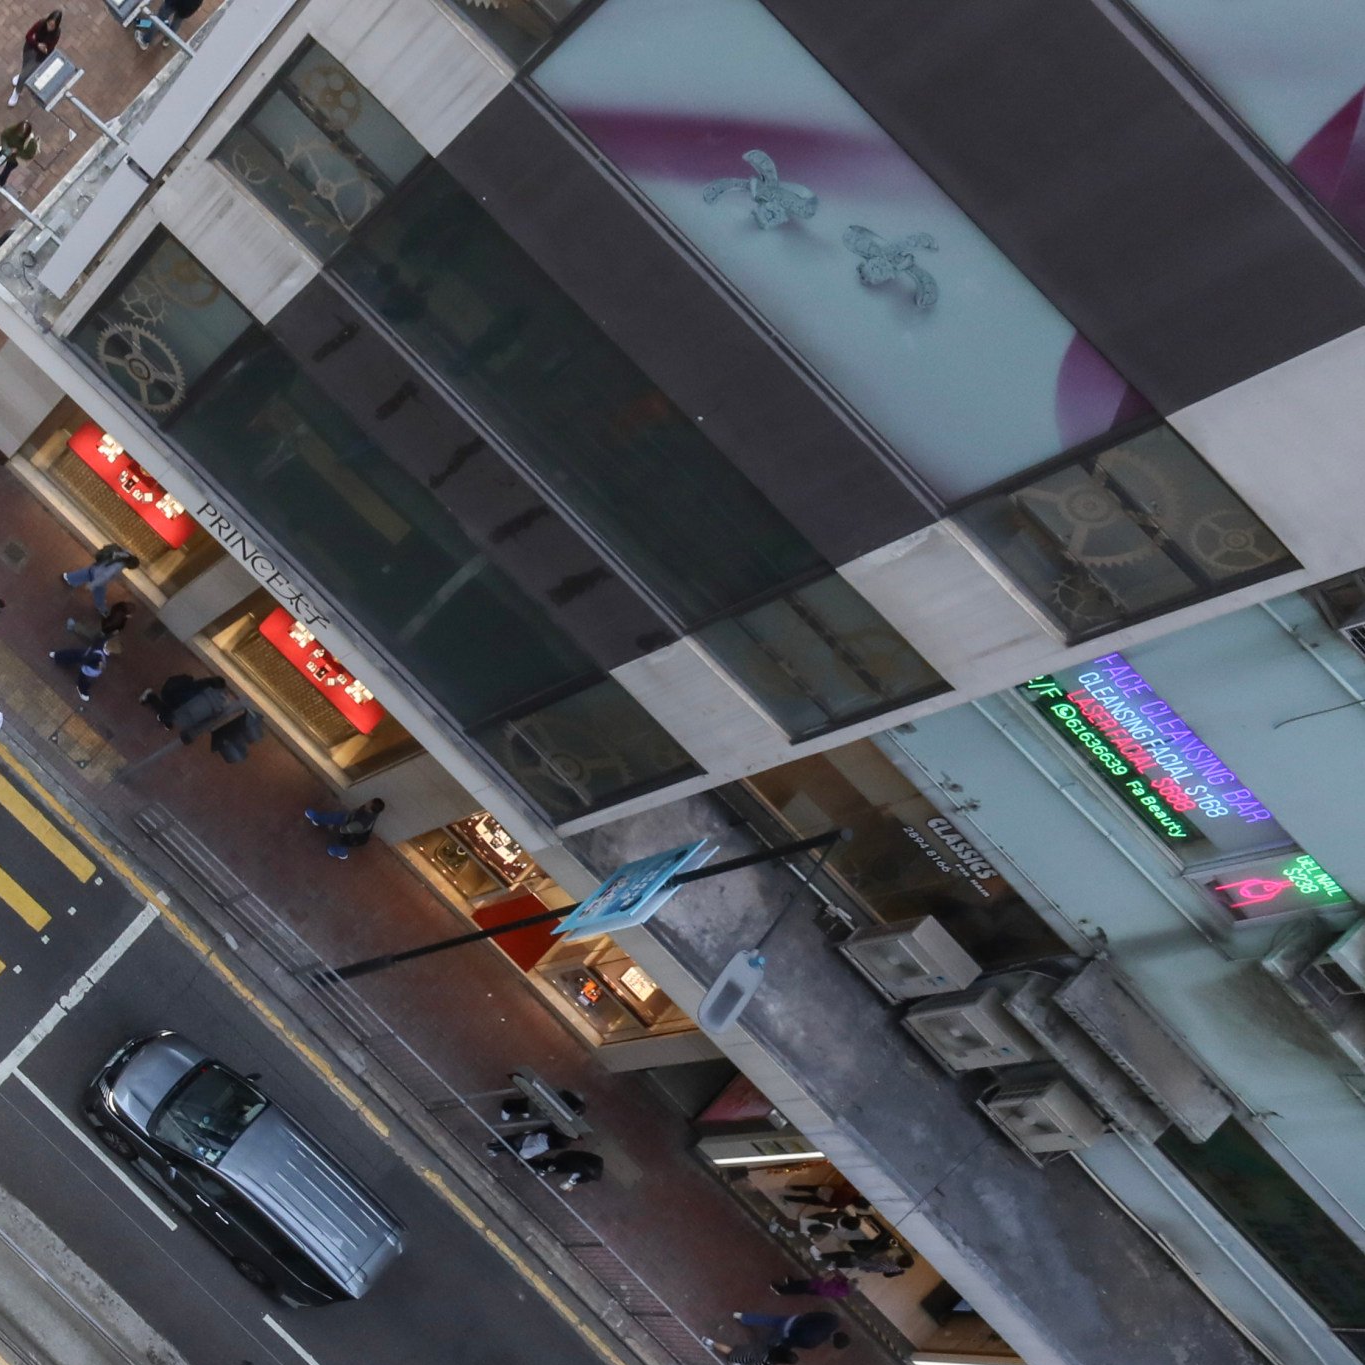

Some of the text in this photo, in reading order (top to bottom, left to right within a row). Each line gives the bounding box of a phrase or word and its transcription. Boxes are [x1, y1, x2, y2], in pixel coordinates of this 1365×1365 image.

[196, 502, 293, 604] PRINCE
[288, 587, 331, 630] 太子
[1066, 688, 1119, 731] LASER
[1104, 728, 1160, 775] FACIAL
[1077, 671, 1155, 741] CLEANSING
[1141, 737, 1194, 786] FACIAL
[1093, 652, 1272, 825] FACE CLEANSING BAR
[1065, 717, 1129, 777] 61636639
[1125, 779, 1146, 798] Fa
[1139, 794, 1188, 839] Beauty
[902, 825, 952, 874] 2894 8166
[926, 817, 999, 880] CLASSICS
[1282, 866, 1320, 895] $238
[1313, 872, 1343, 898] NAIL
